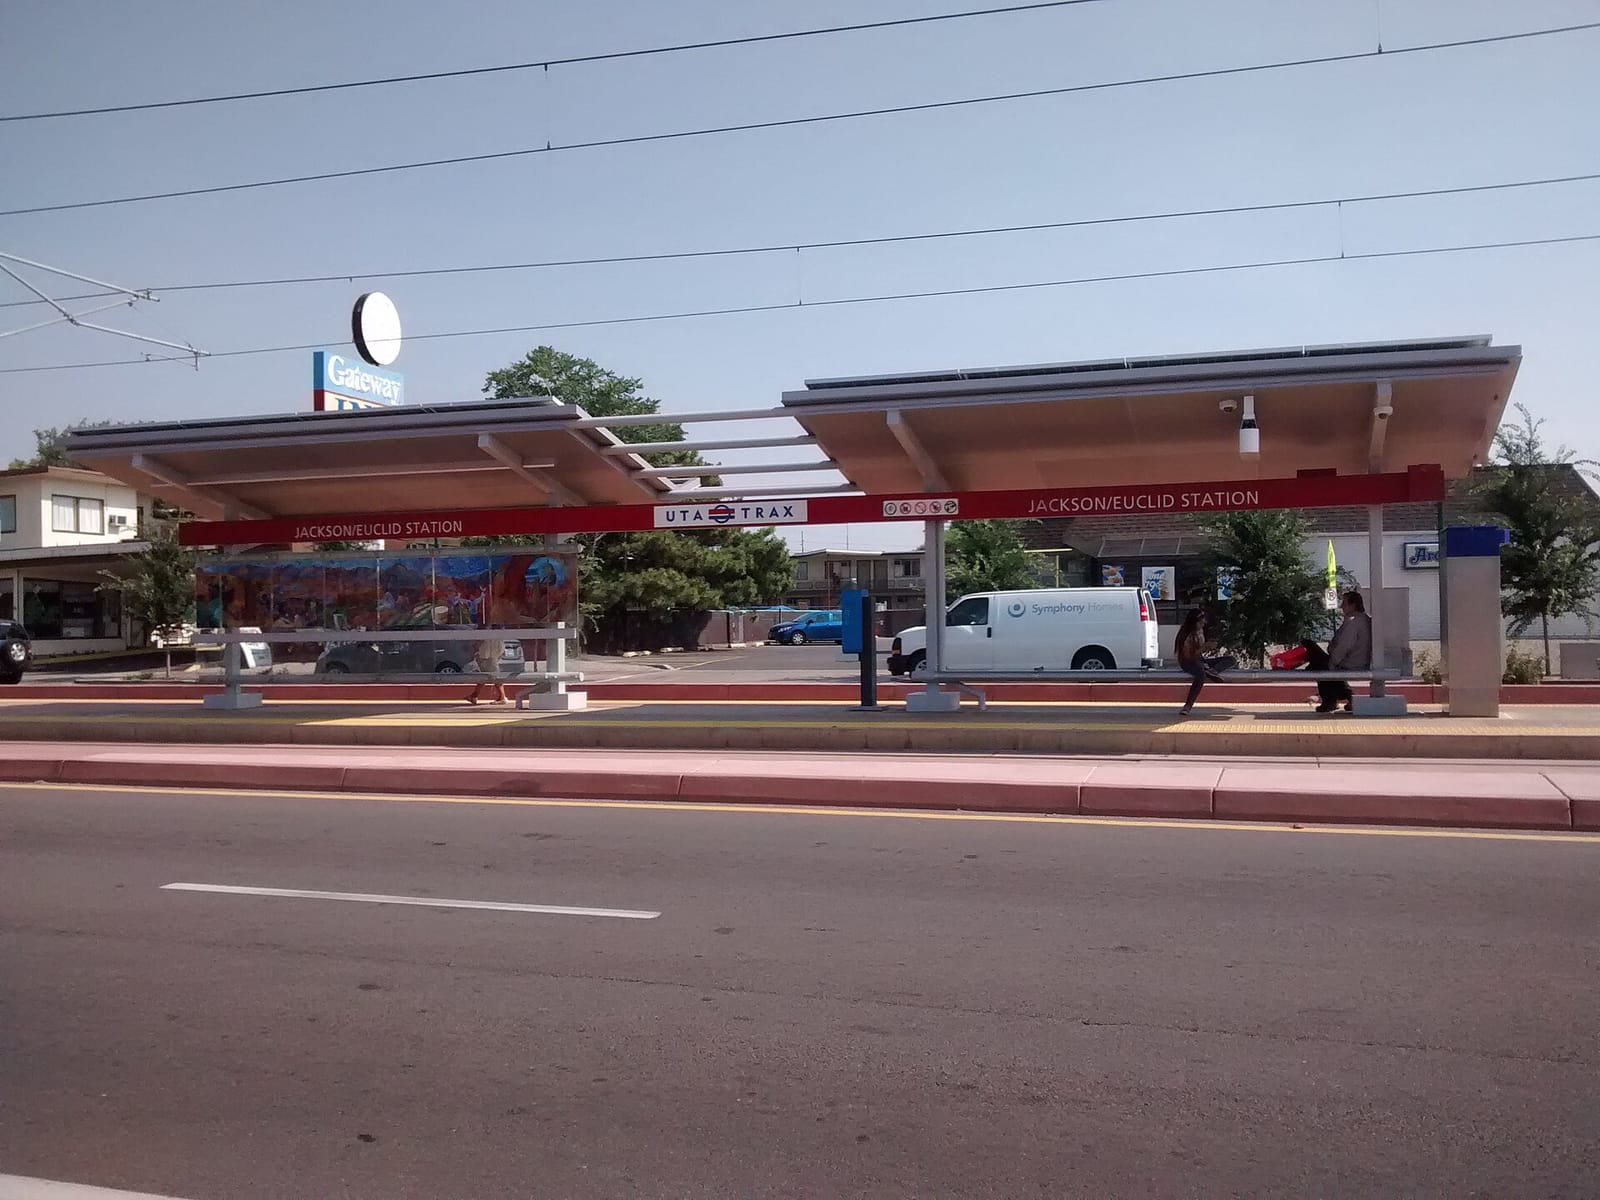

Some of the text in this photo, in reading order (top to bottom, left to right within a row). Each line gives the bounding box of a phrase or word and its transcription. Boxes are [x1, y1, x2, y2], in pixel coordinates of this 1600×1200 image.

[328, 355, 401, 406] Gateway
[1028, 491, 1259, 513] JACKSON/EUCLID STATION
[666, 506, 793, 522] UTA TRAX
[294, 520, 463, 539] JACKSON/EUCLID STATION
[1032, 602, 1085, 615] Symphony
